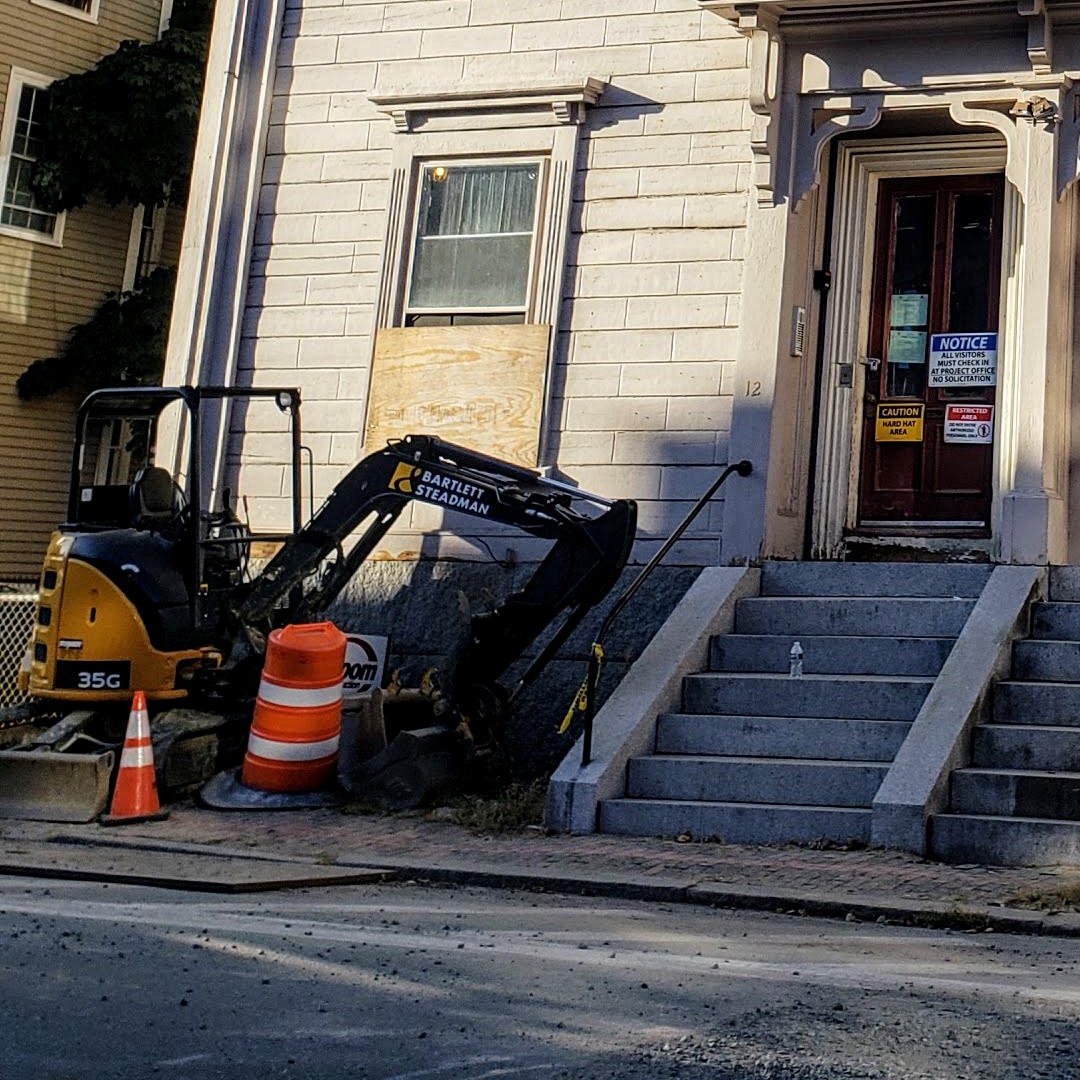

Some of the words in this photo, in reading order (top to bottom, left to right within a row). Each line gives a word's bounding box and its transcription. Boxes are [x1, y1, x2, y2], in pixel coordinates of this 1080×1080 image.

[939, 337, 988, 350] NOTICE
[746, 380, 761, 397] 12
[882, 408, 919, 416] CAUTION
[422, 470, 485, 499] BARTLETT
[414, 484, 490, 514] STEADMAN
[78, 672, 120, 688] 35G
